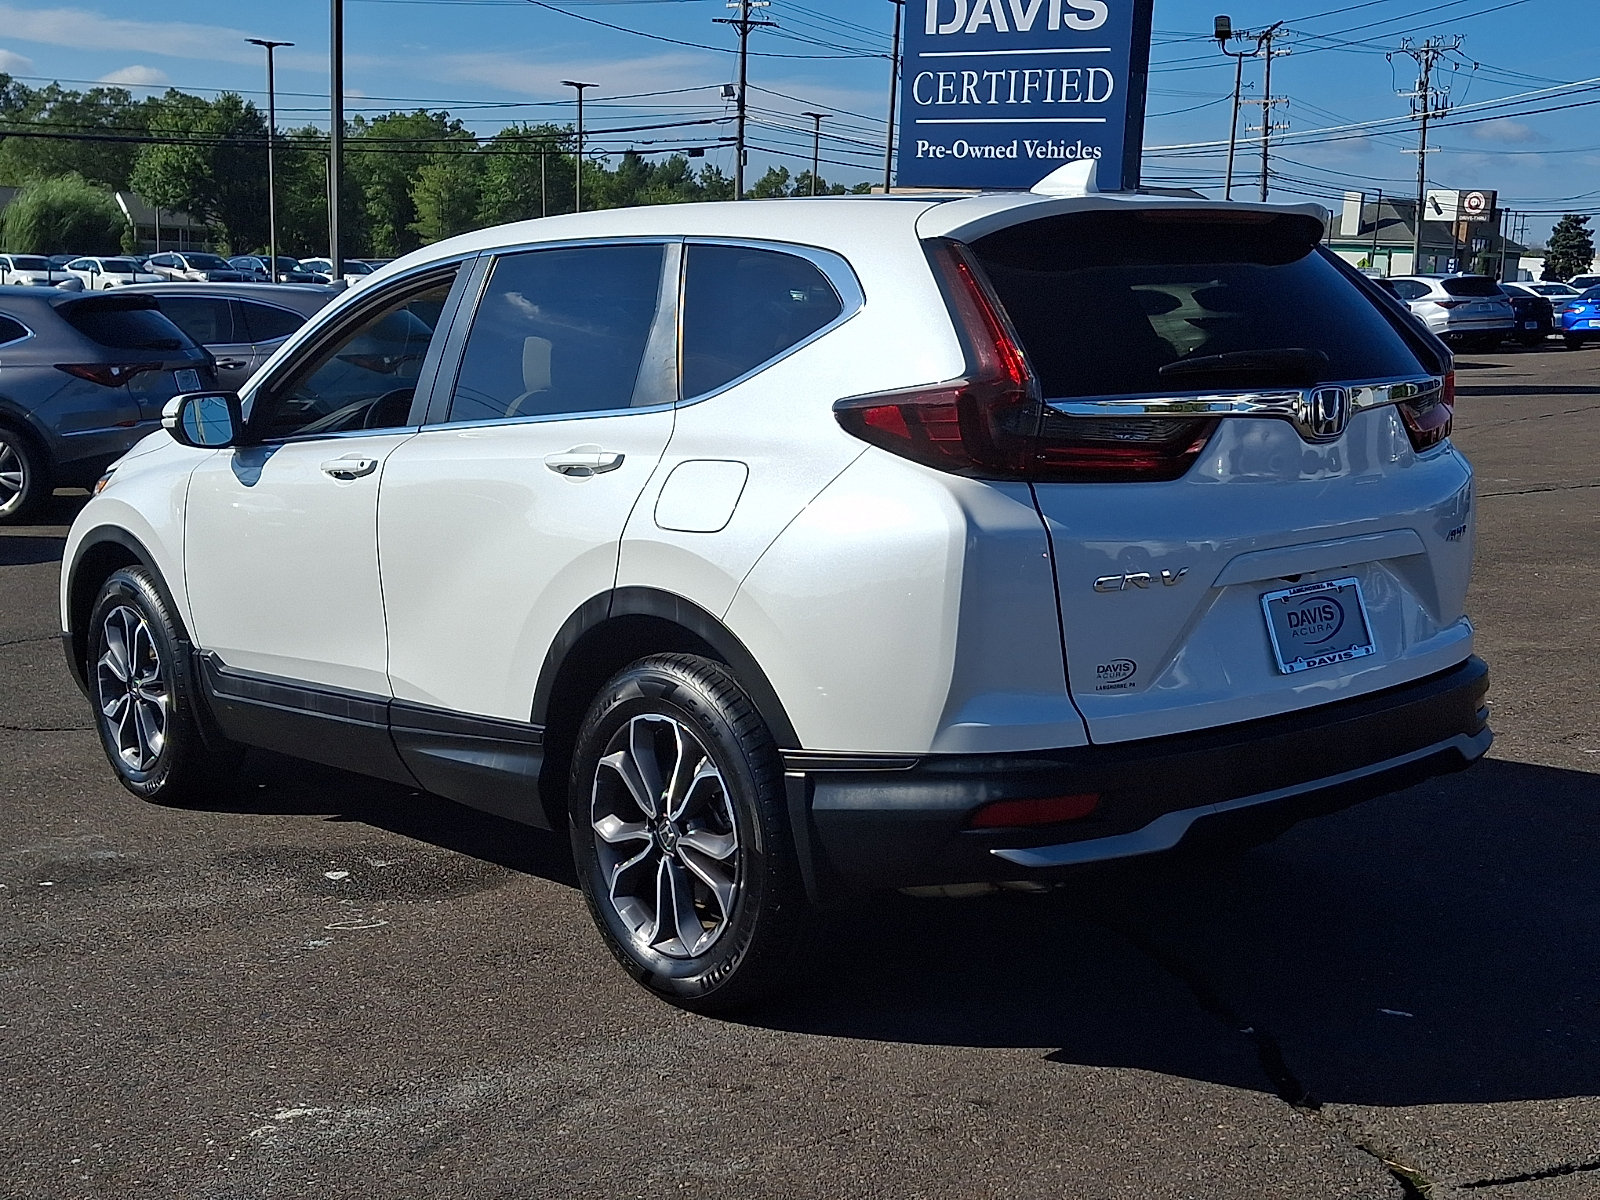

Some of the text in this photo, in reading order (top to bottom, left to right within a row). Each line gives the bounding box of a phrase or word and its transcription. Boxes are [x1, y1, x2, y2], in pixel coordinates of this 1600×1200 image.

[925, 0, 1109, 35] DAVIS
[912, 67, 1114, 105] CERTIFIED
[915, 139, 1102, 160] Pre-Owned Vehicles
[1093, 566, 1189, 593] CR-V
[1287, 604, 1335, 629] DAVIS
[1292, 622, 1334, 638] ACURA
[1096, 663, 1131, 674] DAVIS
[1306, 651, 1354, 668] DAVIS
